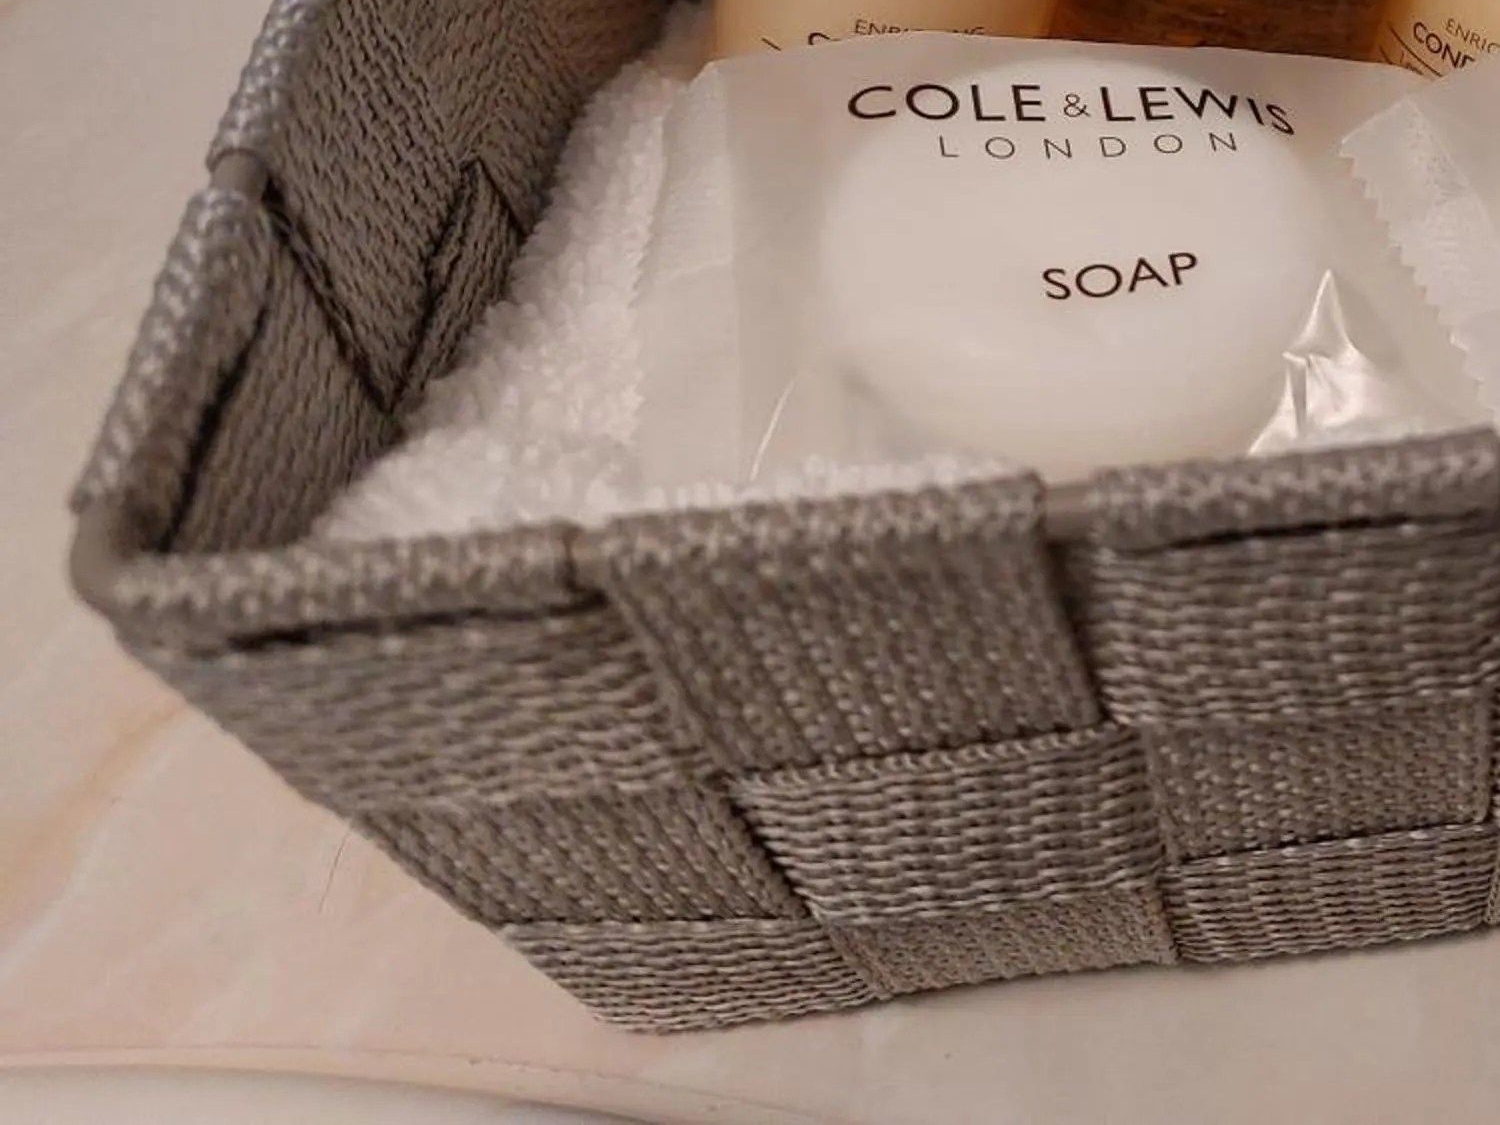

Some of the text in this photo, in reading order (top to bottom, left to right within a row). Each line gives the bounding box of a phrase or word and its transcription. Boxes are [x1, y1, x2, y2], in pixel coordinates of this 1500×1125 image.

[847, 83, 1046, 122] COLE
[1100, 85, 1295, 135] LEWIS
[939, 132, 1238, 160] LONDON
[1042, 252, 1198, 300] SOAP
